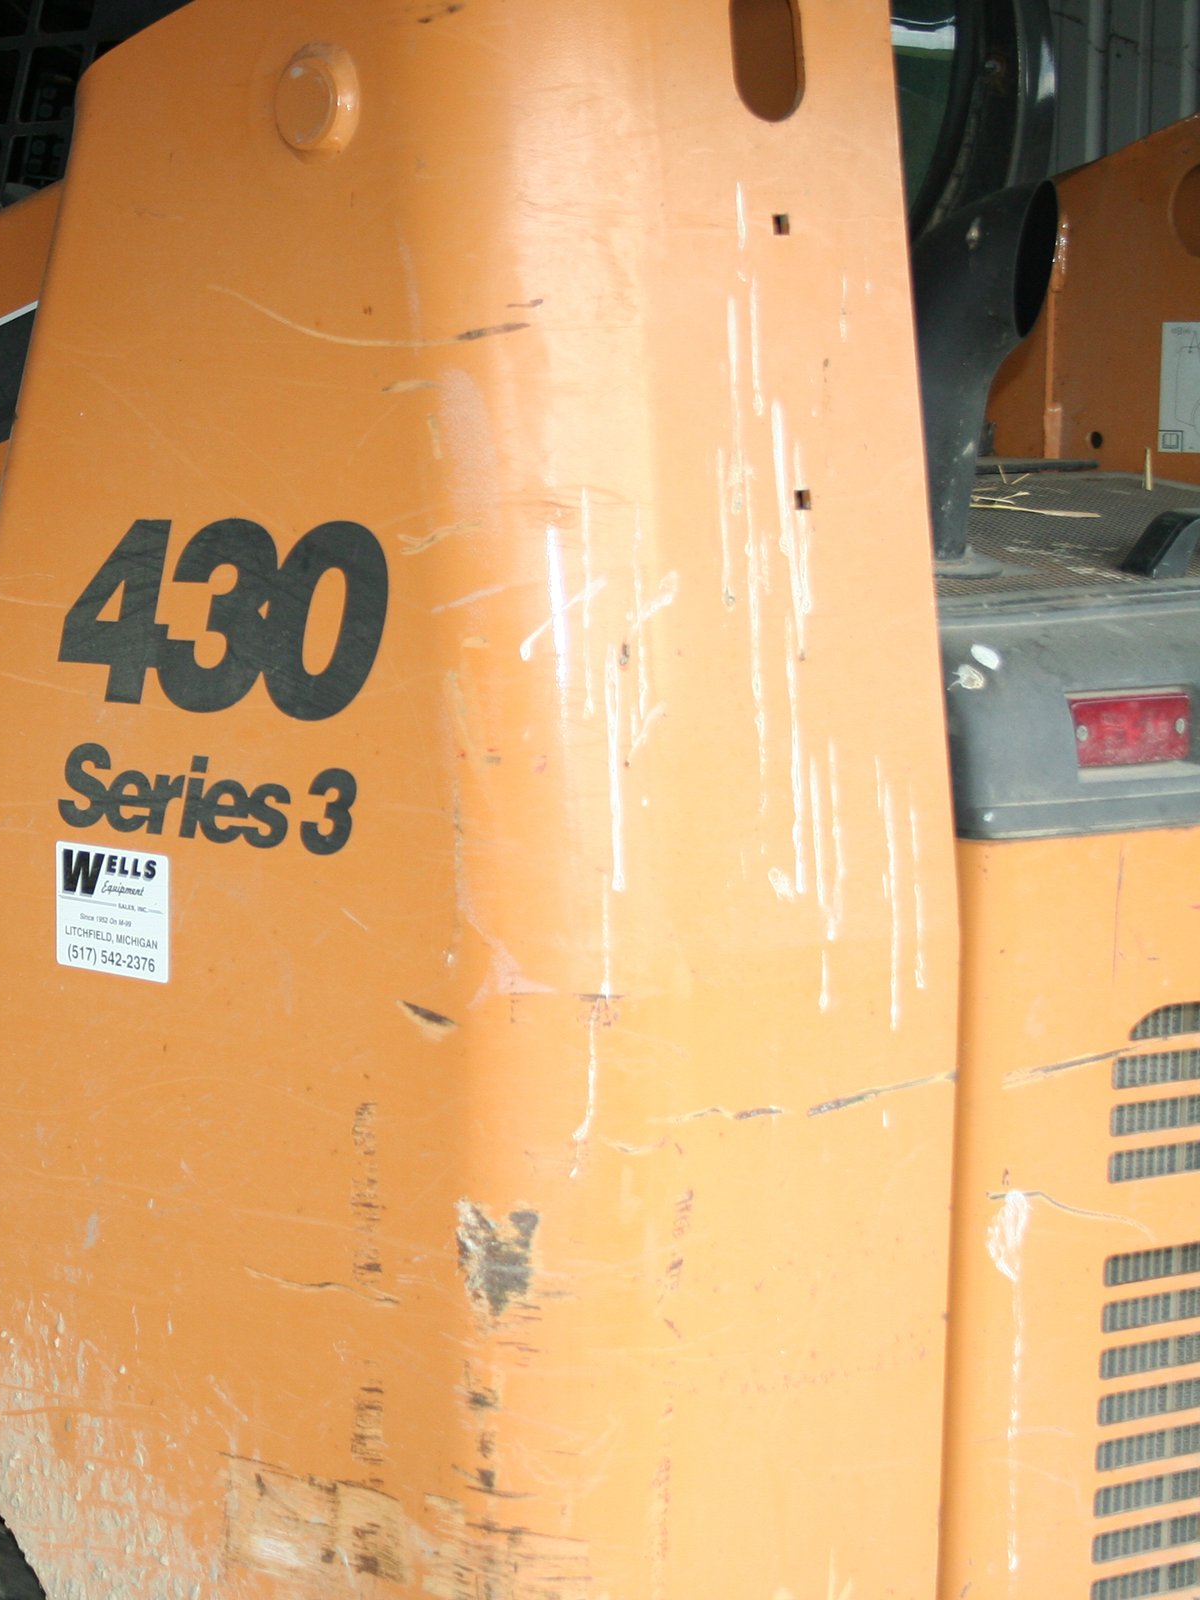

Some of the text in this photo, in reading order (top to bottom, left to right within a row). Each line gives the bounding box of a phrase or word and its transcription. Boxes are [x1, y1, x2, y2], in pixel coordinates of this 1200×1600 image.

[57, 517, 389, 722] 430
[57, 742, 357, 855] Series 3
[62, 848, 157, 896] WELLS
[100, 880, 145, 897] Equipment
[79, 912, 95, 921] Since
[109, 917, 118, 925] On
[118, 903, 136, 912] SALES,
[64, 925, 159, 950] LITCHFIELD, MICHIGAN
[67, 943, 156, 973] (517) 542-2376
